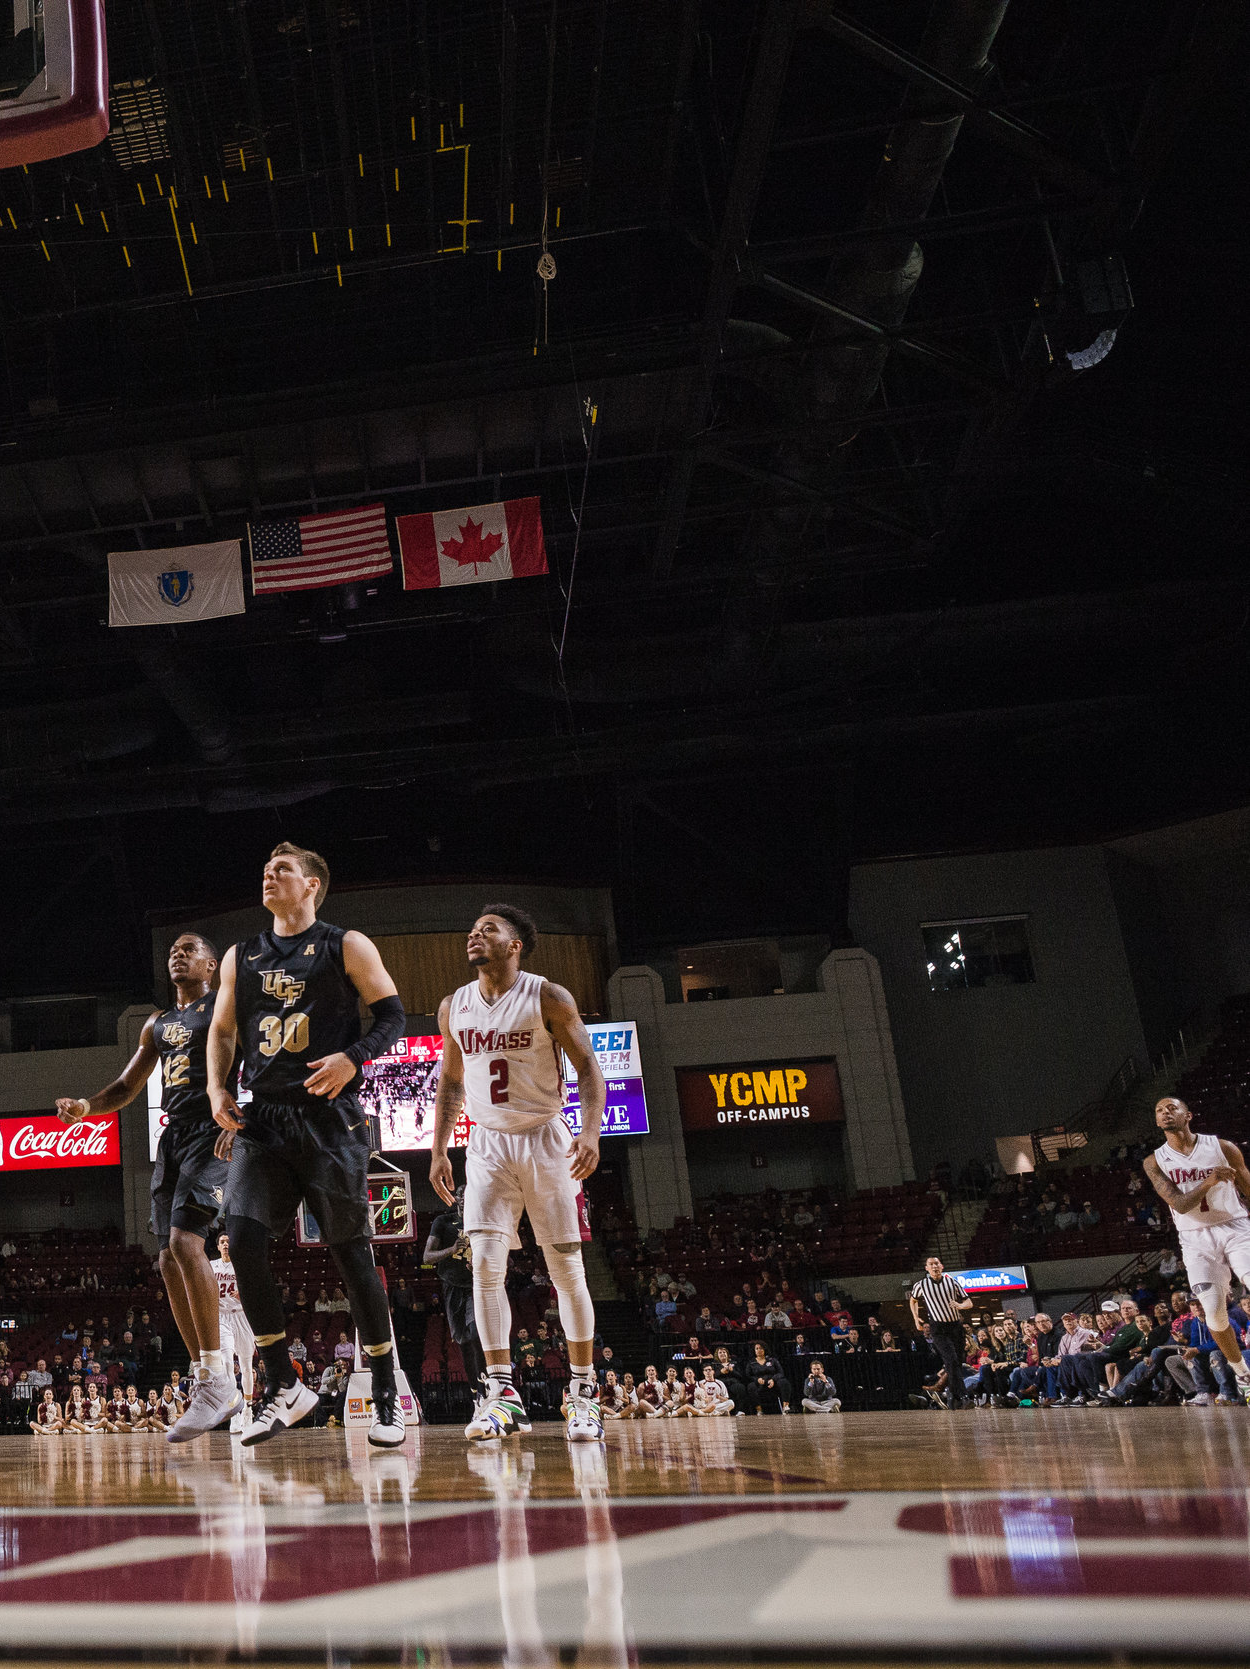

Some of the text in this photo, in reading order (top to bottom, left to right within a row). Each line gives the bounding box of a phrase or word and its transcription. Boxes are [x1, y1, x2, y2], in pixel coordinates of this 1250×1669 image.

[258, 968, 305, 1008] UCF
[162, 1021, 193, 1051] UCF
[258, 1012, 310, 1057] 30
[589, 1030, 633, 1052] EEI
[610, 1051, 631, 1063] FM
[162, 1054, 191, 1088] 12
[489, 1058, 510, 1105] 2
[608, 1082, 626, 1091] first
[708, 1068, 808, 1108] YCMP
[716, 1106, 810, 1123] OFF-CAMPUS
[455, 1125, 467, 1135] 30
[610, 1123, 630, 1132] UNION
[9, 1120, 113, 1159] Coca-Cola
[219, 1282, 236, 1298] 24
[956, 1273, 1010, 1288] Domino's
